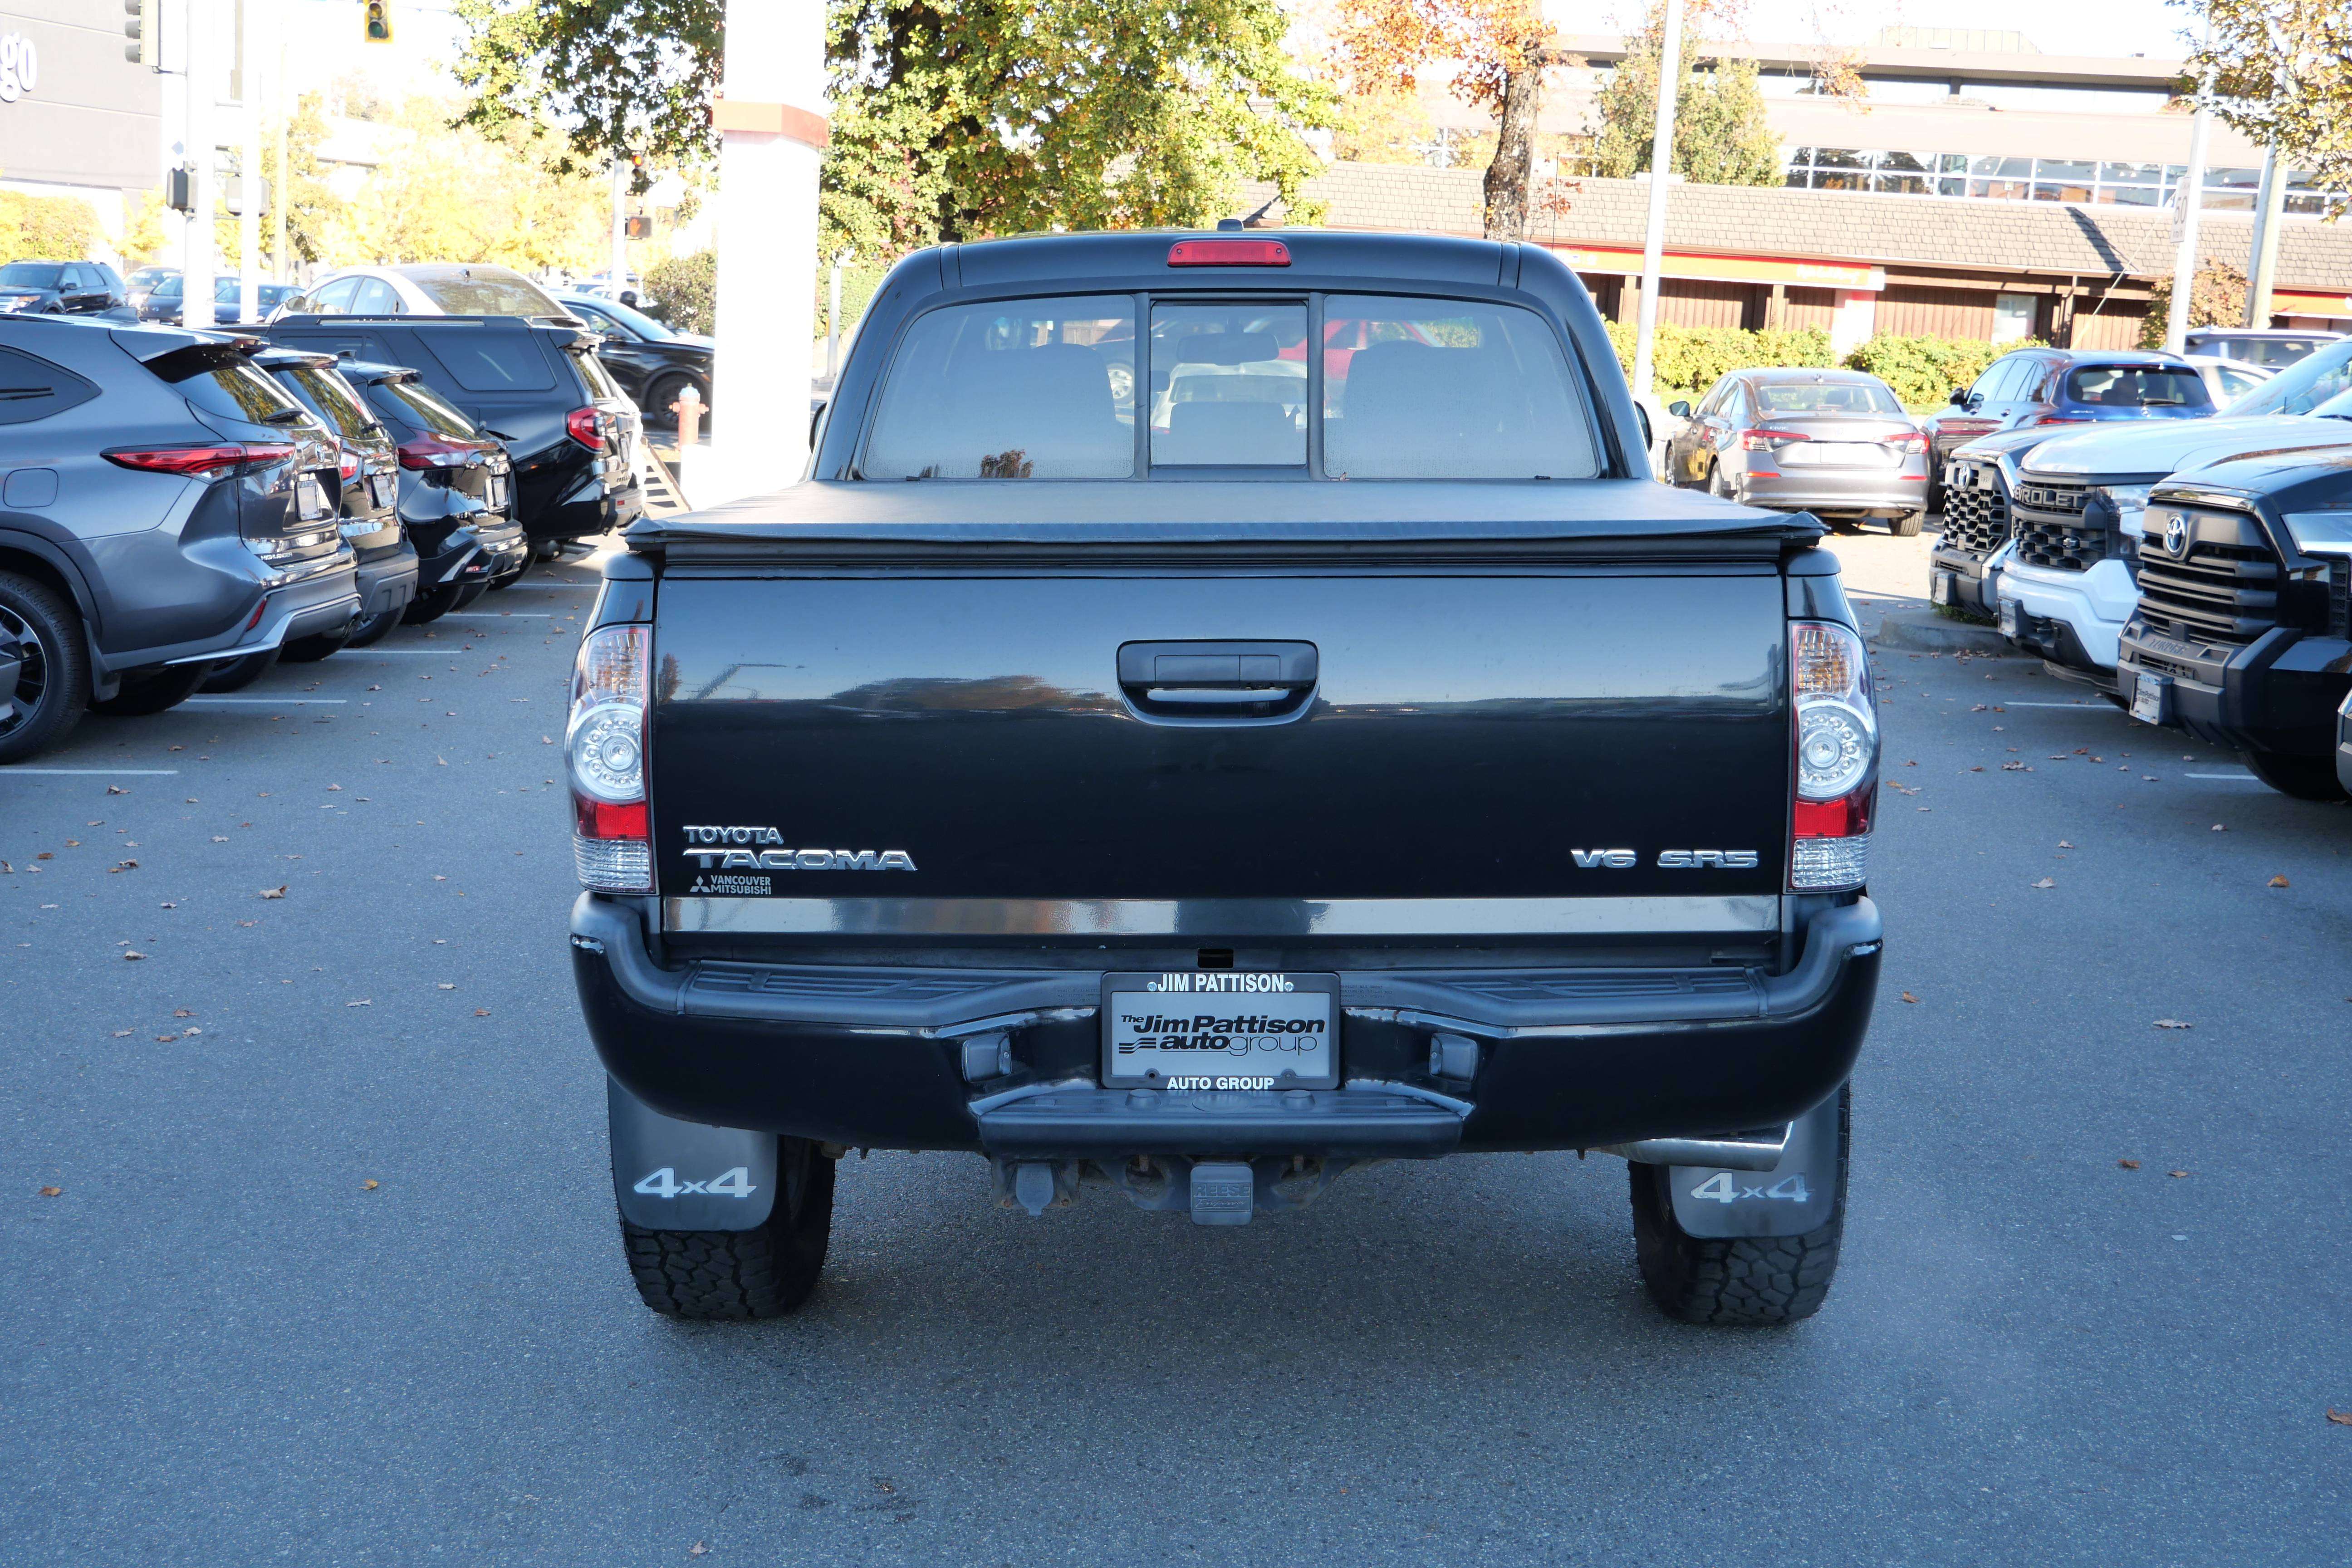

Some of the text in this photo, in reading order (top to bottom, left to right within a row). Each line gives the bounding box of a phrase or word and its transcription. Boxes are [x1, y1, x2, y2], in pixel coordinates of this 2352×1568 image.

[2174, 196, 2187, 225] 50
[2014, 485, 2082, 508] EVROLET
[260, 552, 293, 561] HIGHLANDER
[682, 826, 784, 845] TOYOTA
[682, 848, 918, 871] TACOMA
[1570, 849, 1758, 868] V6 SR5
[710, 875, 771, 886] VANCOUVER
[710, 884, 771, 895] MITSUBISHI
[1157, 974, 1284, 992] JIM PATTISON
[1121, 1014, 1325, 1033] The Jim Pattison
[1167, 1077, 1274, 1090] AUTO GROUP
[633, 1166, 757, 1198] 4x4
[1194, 1183, 1250, 1197] REESE
[1690, 1172, 1814, 1203] 4x4
